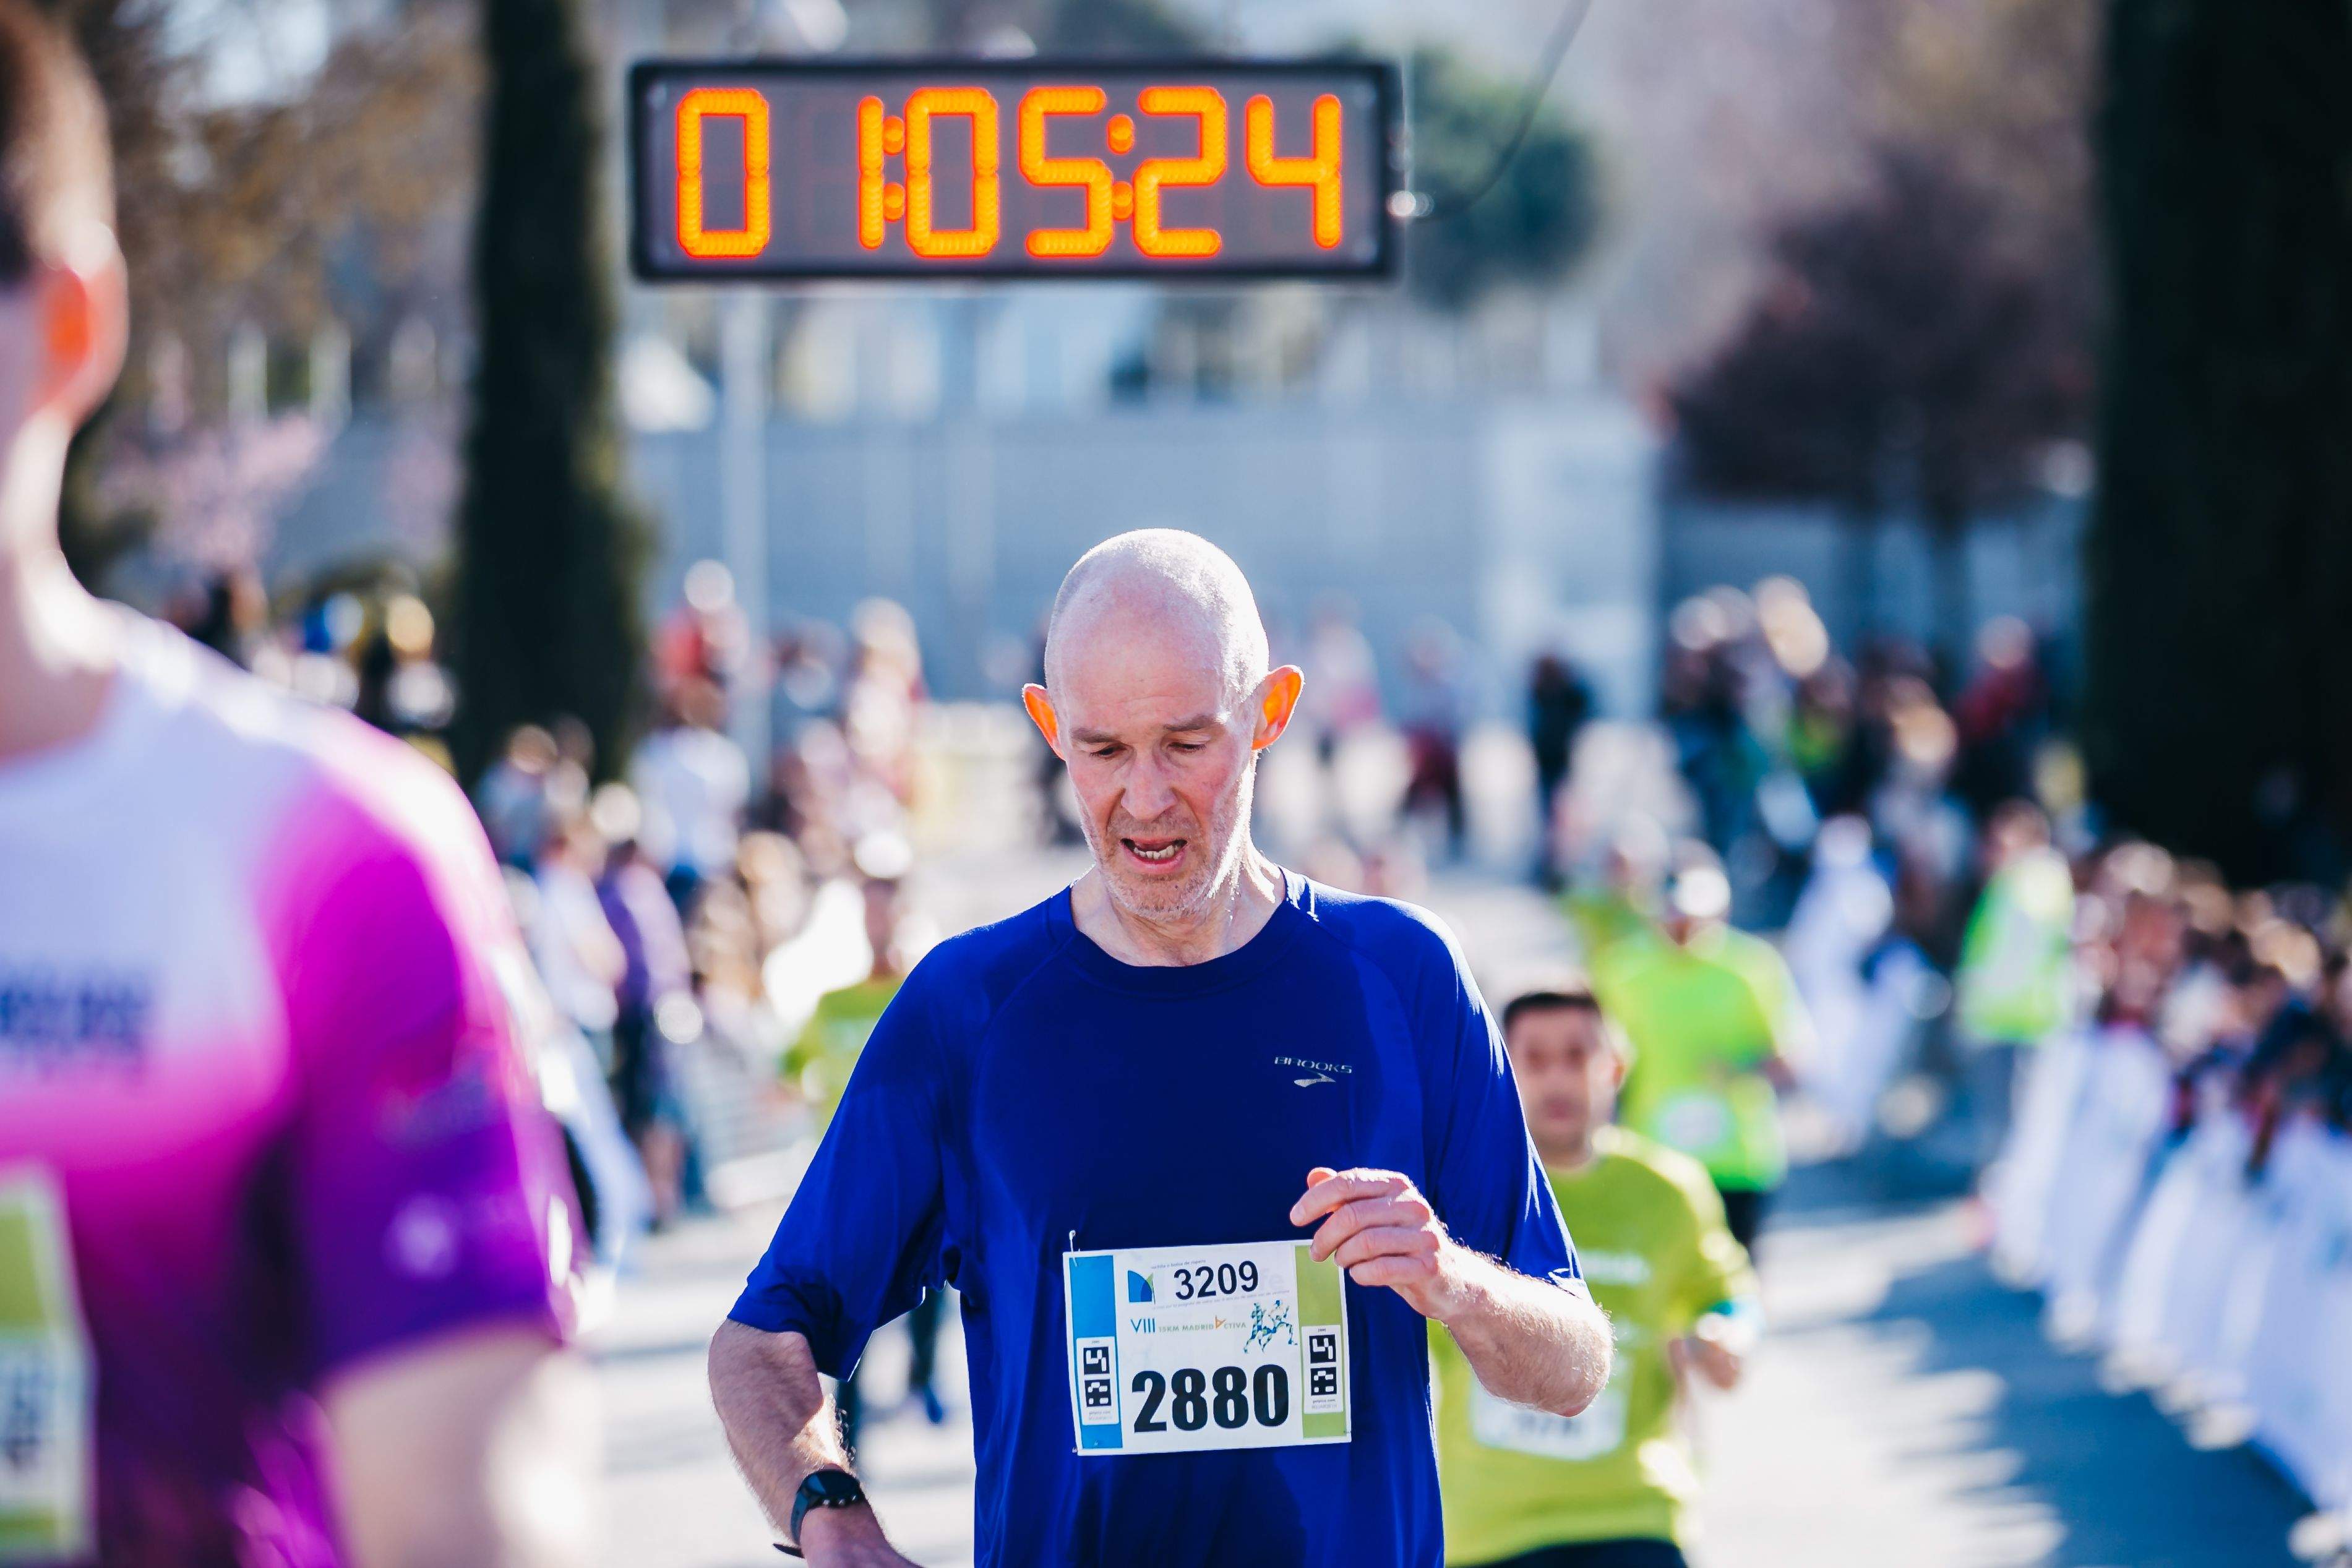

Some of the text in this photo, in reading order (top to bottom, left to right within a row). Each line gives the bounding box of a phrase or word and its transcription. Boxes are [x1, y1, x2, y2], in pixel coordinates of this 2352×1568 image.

[1274, 1056, 1353, 1074] BROOKS
[1174, 1260, 1258, 1300] 3209
[1130, 1318, 1156, 1334] VIII
[1182, 1323, 1214, 1332] MADRID
[1131, 1364, 1289, 1433] 2880
